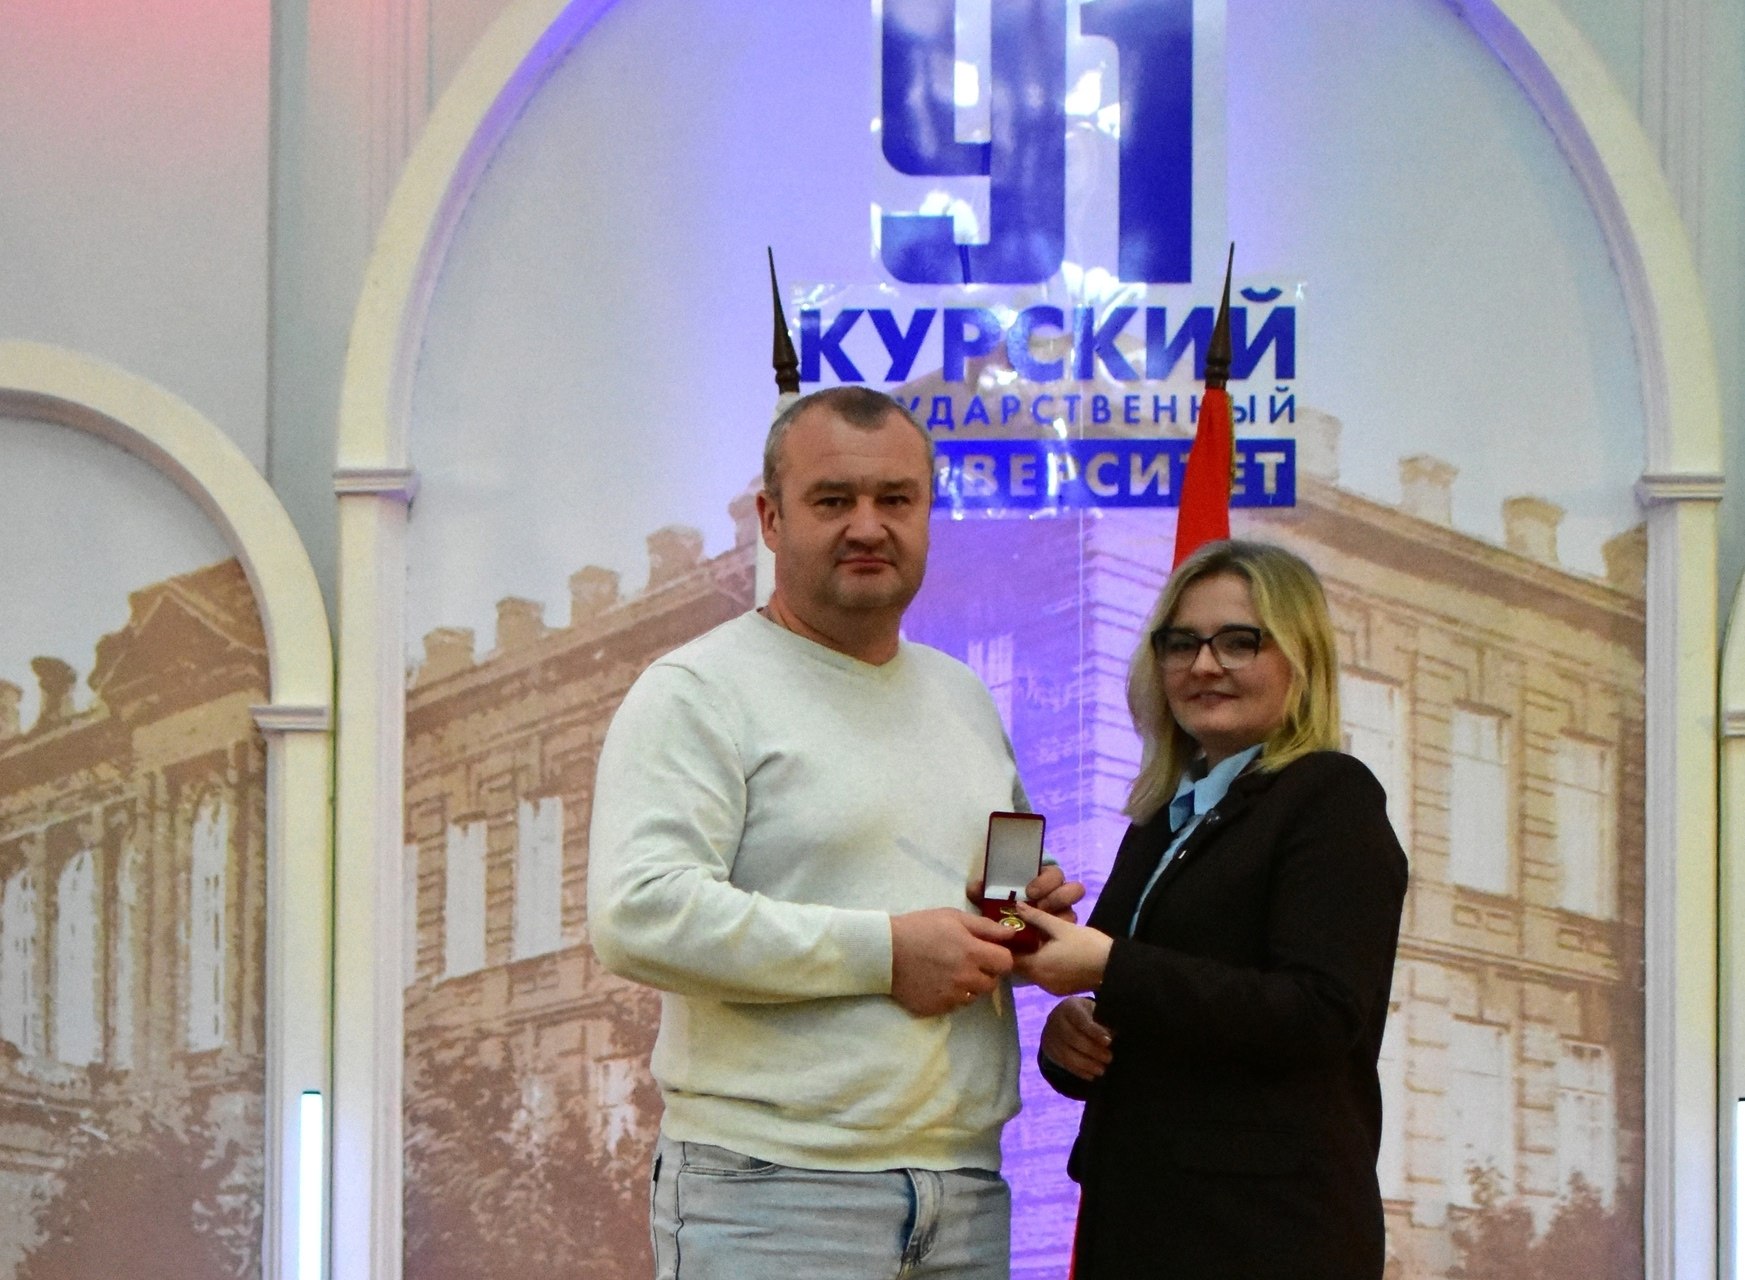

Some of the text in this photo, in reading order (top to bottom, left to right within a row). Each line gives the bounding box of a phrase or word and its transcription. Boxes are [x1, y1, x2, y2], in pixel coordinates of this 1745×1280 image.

[799, 287, 1296, 383] КУРСКИЙ
[896, 386, 1296, 431] ДАРСТВЕНЫЙ
[935, 451, 1286, 498] ВЕРСИТ
